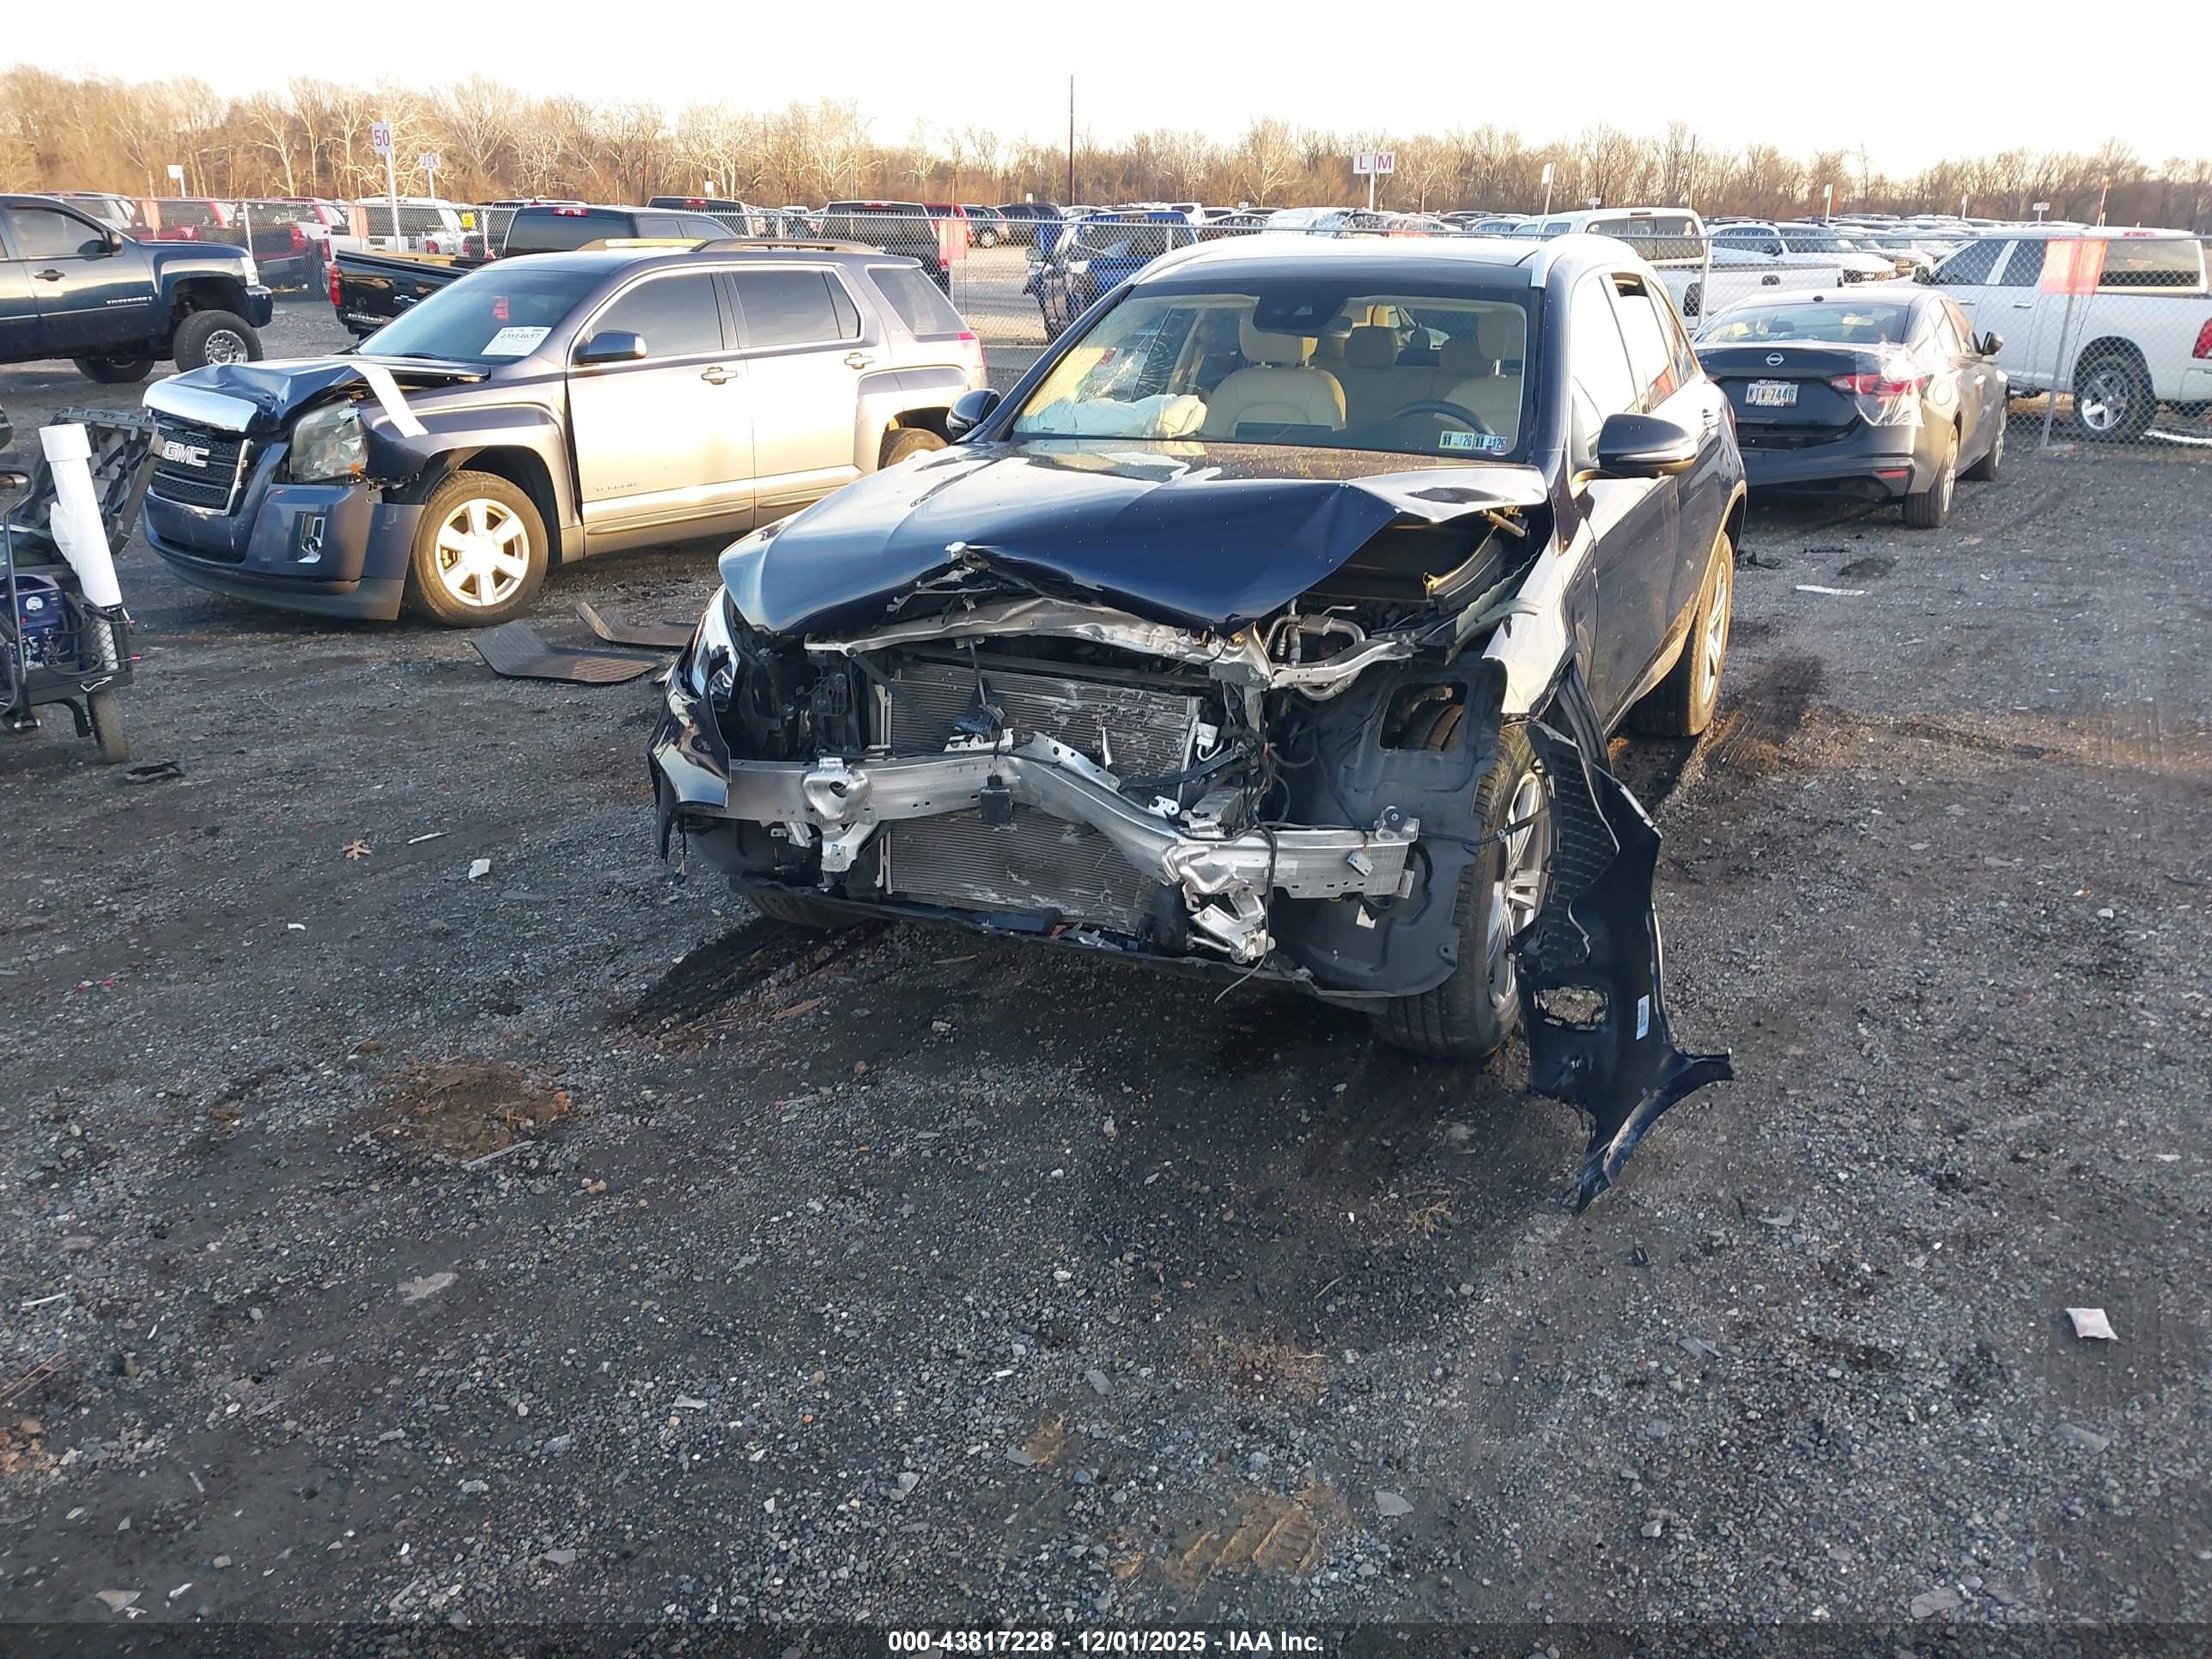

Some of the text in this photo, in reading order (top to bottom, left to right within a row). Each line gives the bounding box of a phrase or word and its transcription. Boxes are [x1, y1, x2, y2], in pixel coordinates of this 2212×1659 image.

[374, 129, 391, 147] 50
[1359, 155, 1392, 169] L M
[163, 441, 210, 467] GMC
